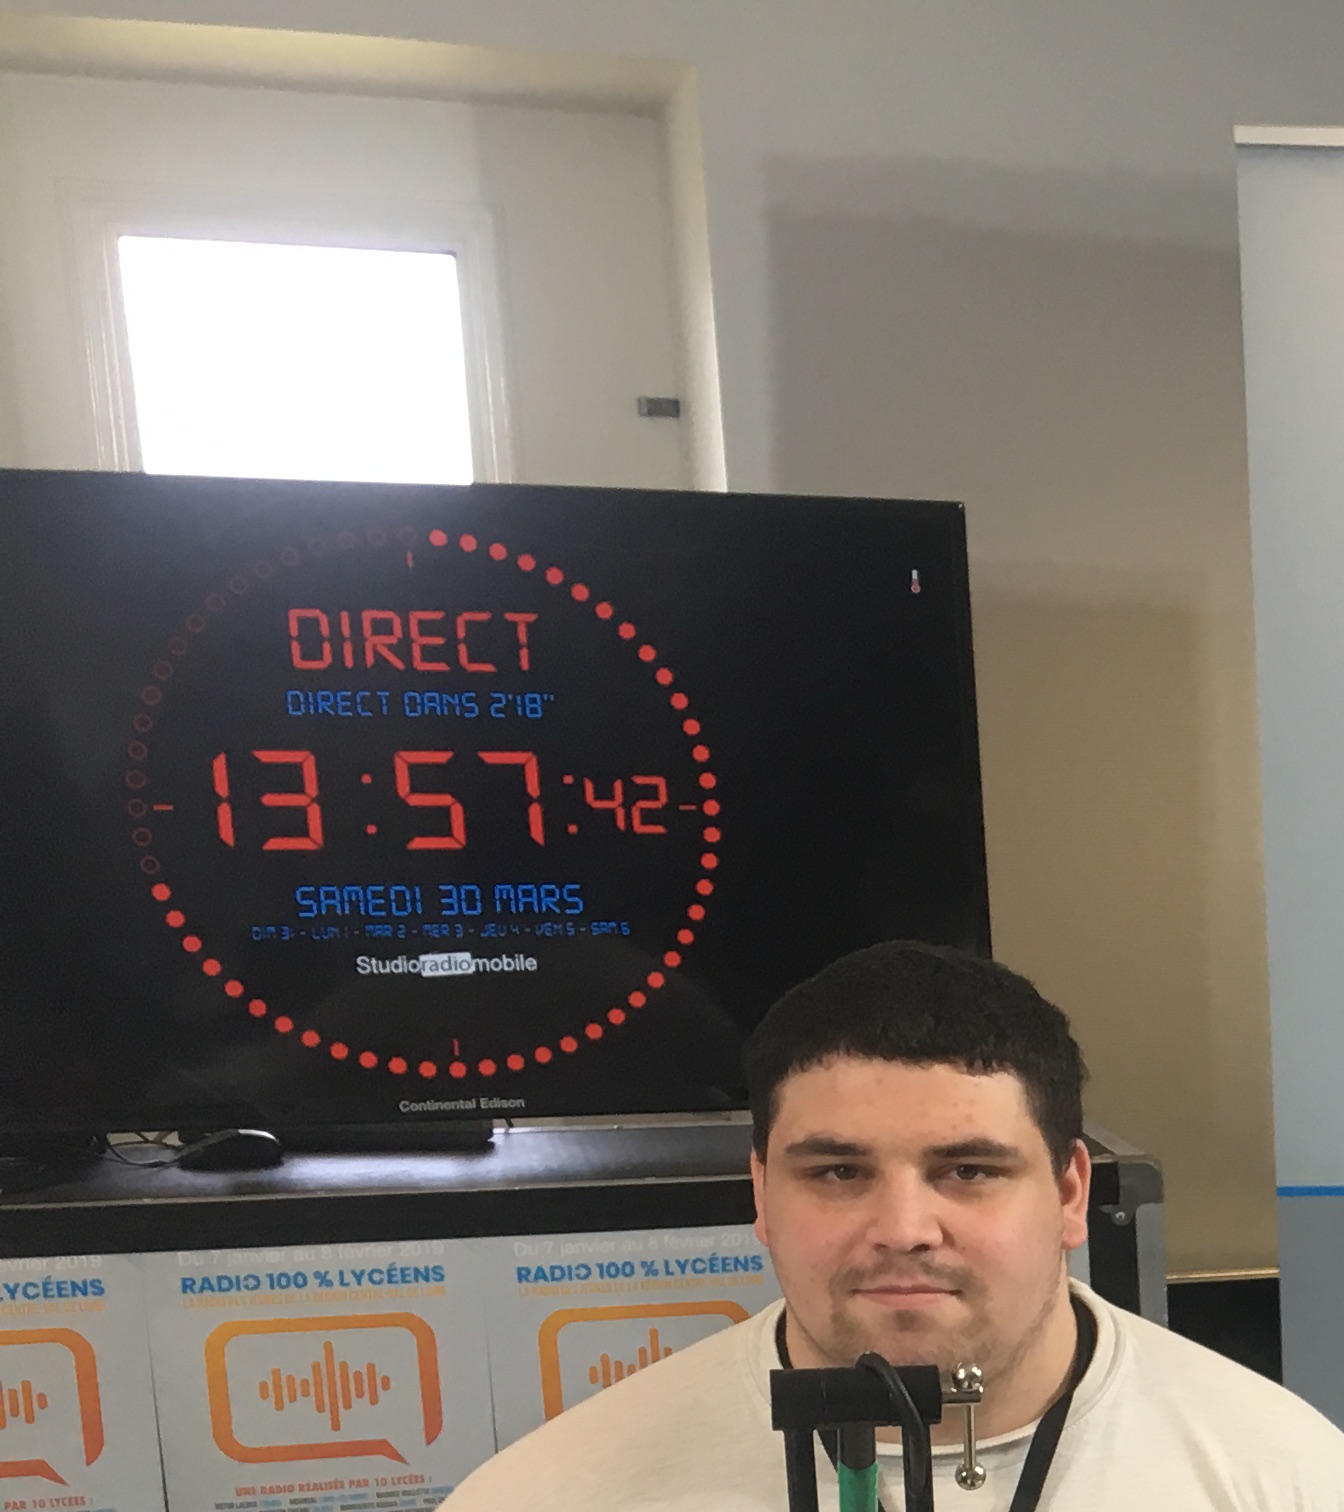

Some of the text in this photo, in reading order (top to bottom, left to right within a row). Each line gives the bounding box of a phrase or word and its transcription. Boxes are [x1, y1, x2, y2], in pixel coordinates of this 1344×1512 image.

[287, 608, 539, 673] DIRECT
[286, 690, 390, 718] DIRECT
[404, 692, 478, 718] DANS
[295, 883, 584, 918] SAMEDI 30 MARS
[398, 1097, 526, 1112] Continental Edison
[0, 1256, 47, 1272] vrier
[180, 1261, 446, 1295] RADIO 100 % LYCÉENS
[516, 1252, 764, 1284] RADIO 100 % LYCÉENS
[0, 1275, 105, 1301] YCÉENS
[260, 1483, 294, 1495] RADIO
[348, 1478, 370, 1489] PAR
